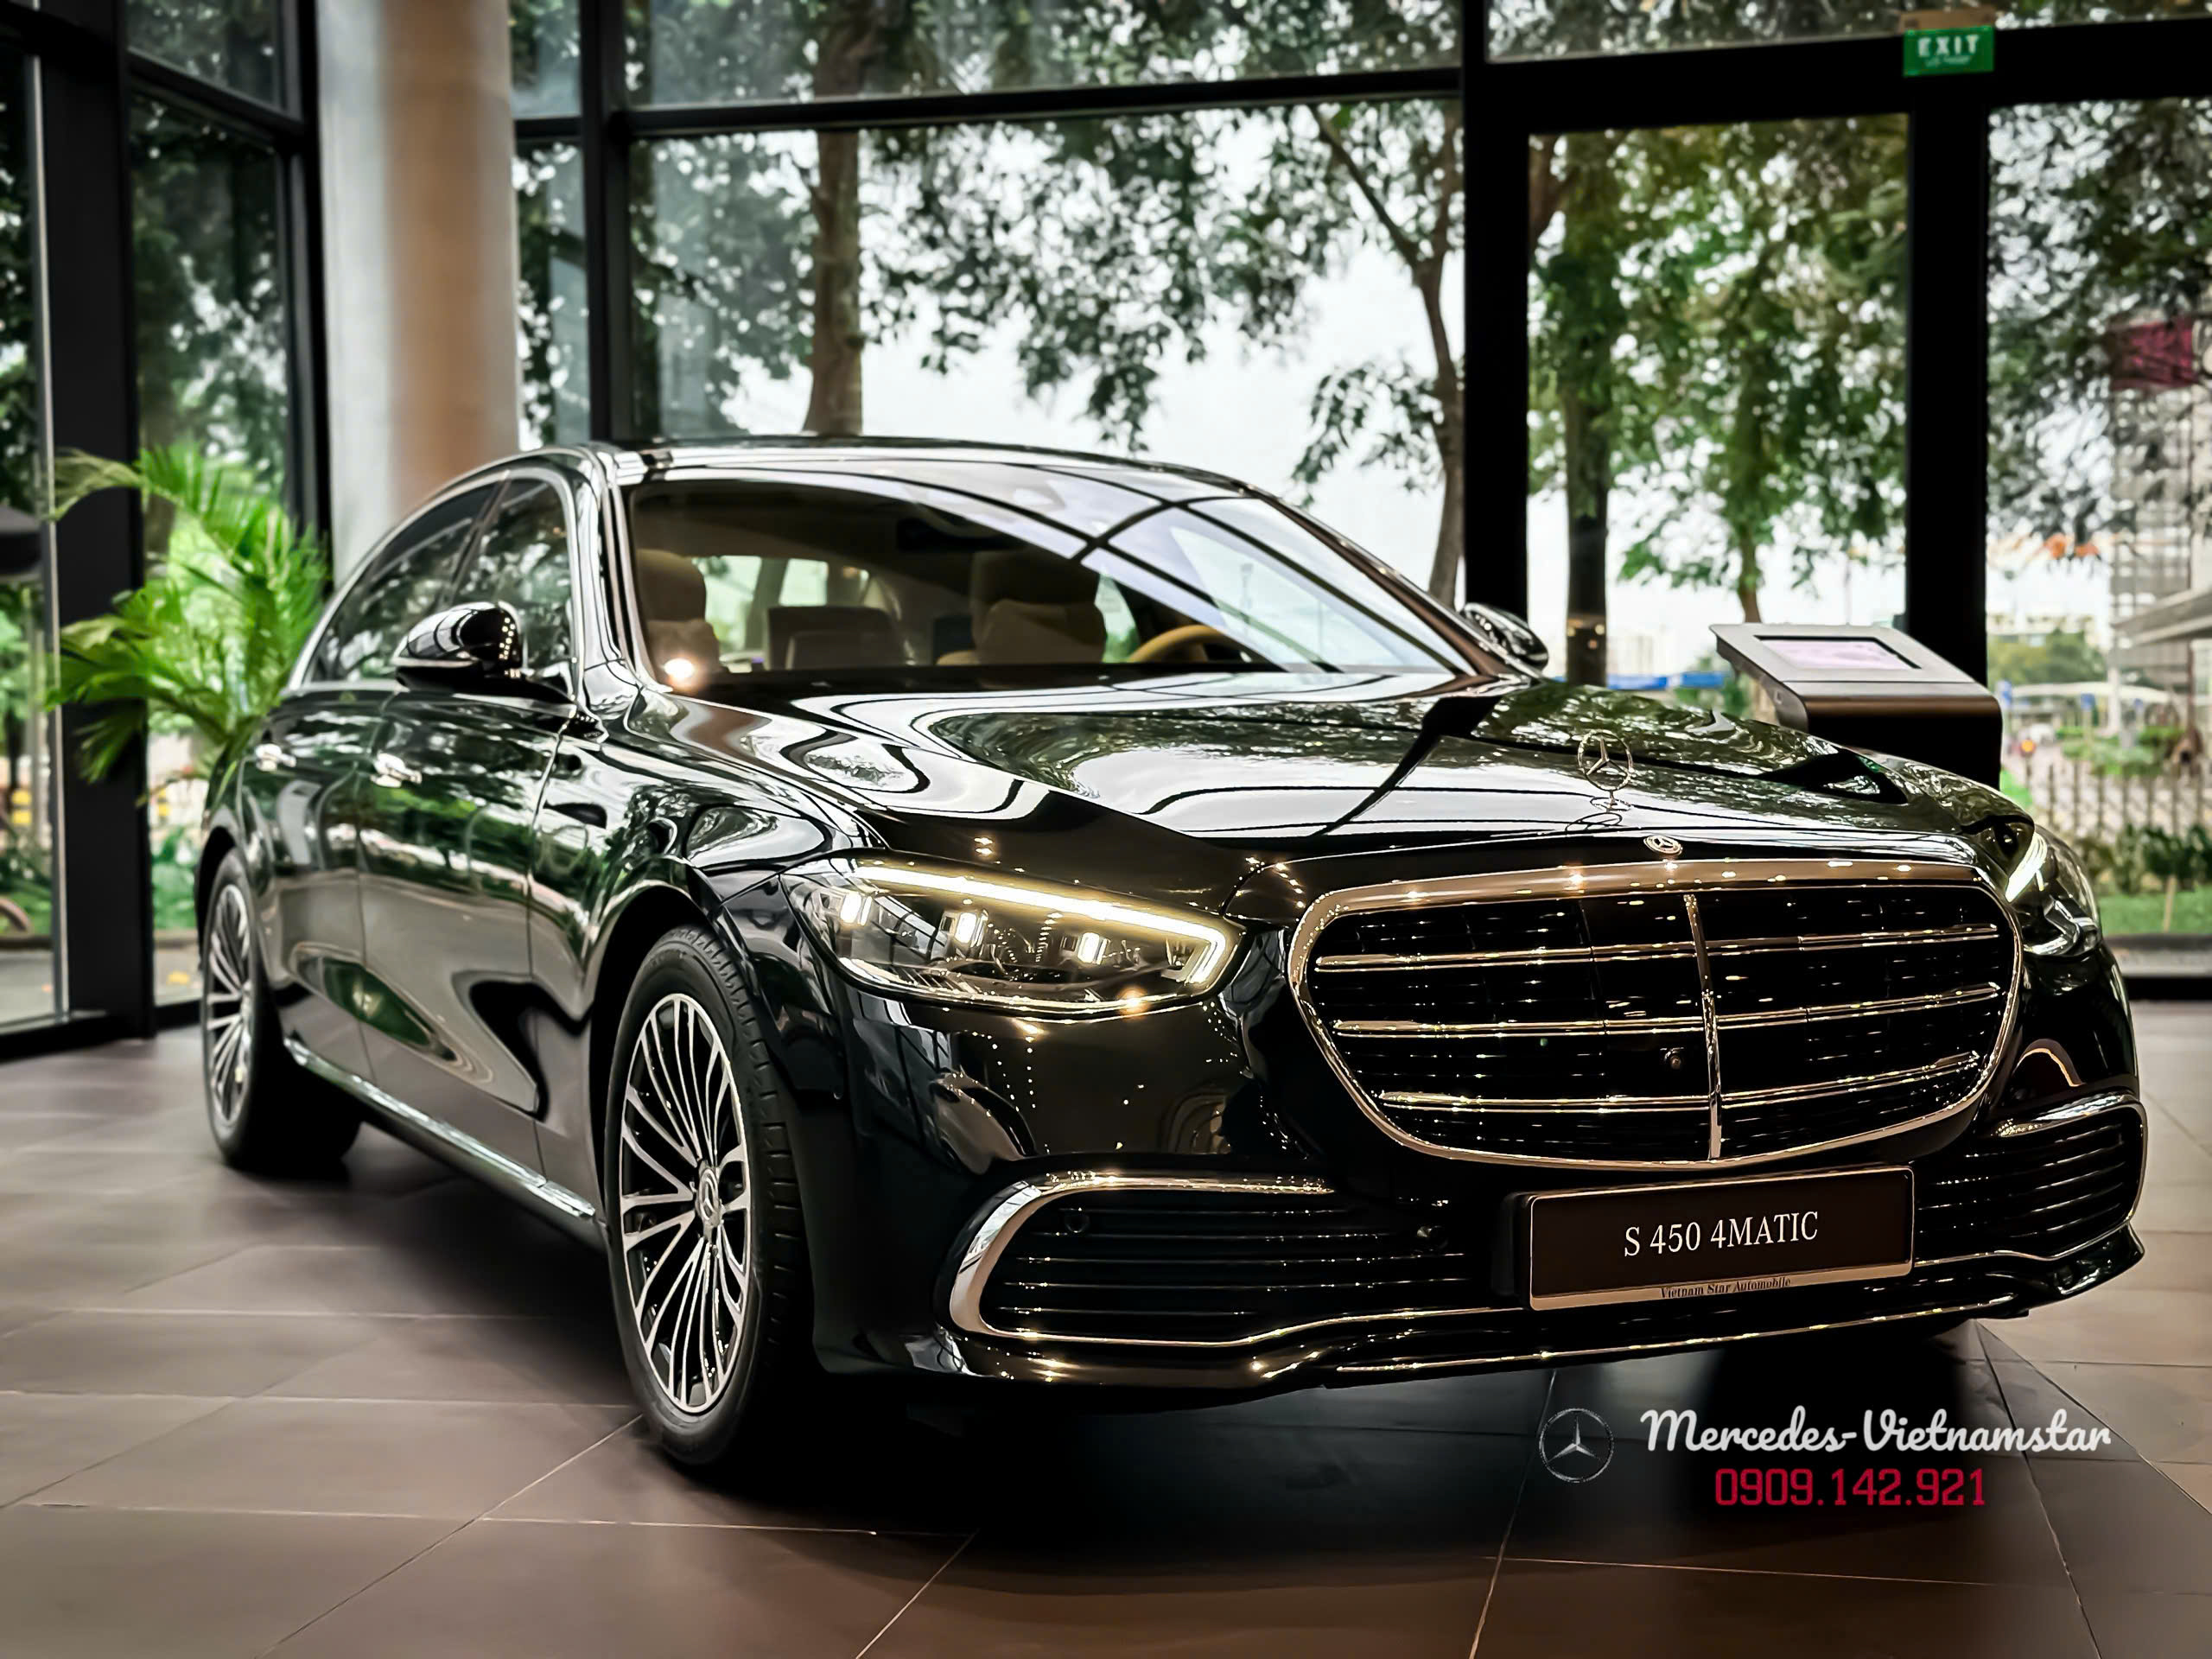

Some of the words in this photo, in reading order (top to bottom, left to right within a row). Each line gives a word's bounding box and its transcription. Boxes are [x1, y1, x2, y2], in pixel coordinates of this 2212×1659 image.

[1917, 35, 1980, 57] EXIT
[1624, 1226, 1641, 1257] S
[1649, 1221, 1701, 1255] 450
[1710, 1211, 1818, 1249] 4MATIC
[1661, 1285, 1704, 1299] Vietnam
[1707, 1283, 1732, 1294] Star
[1734, 1276, 1791, 1293] Automobile
